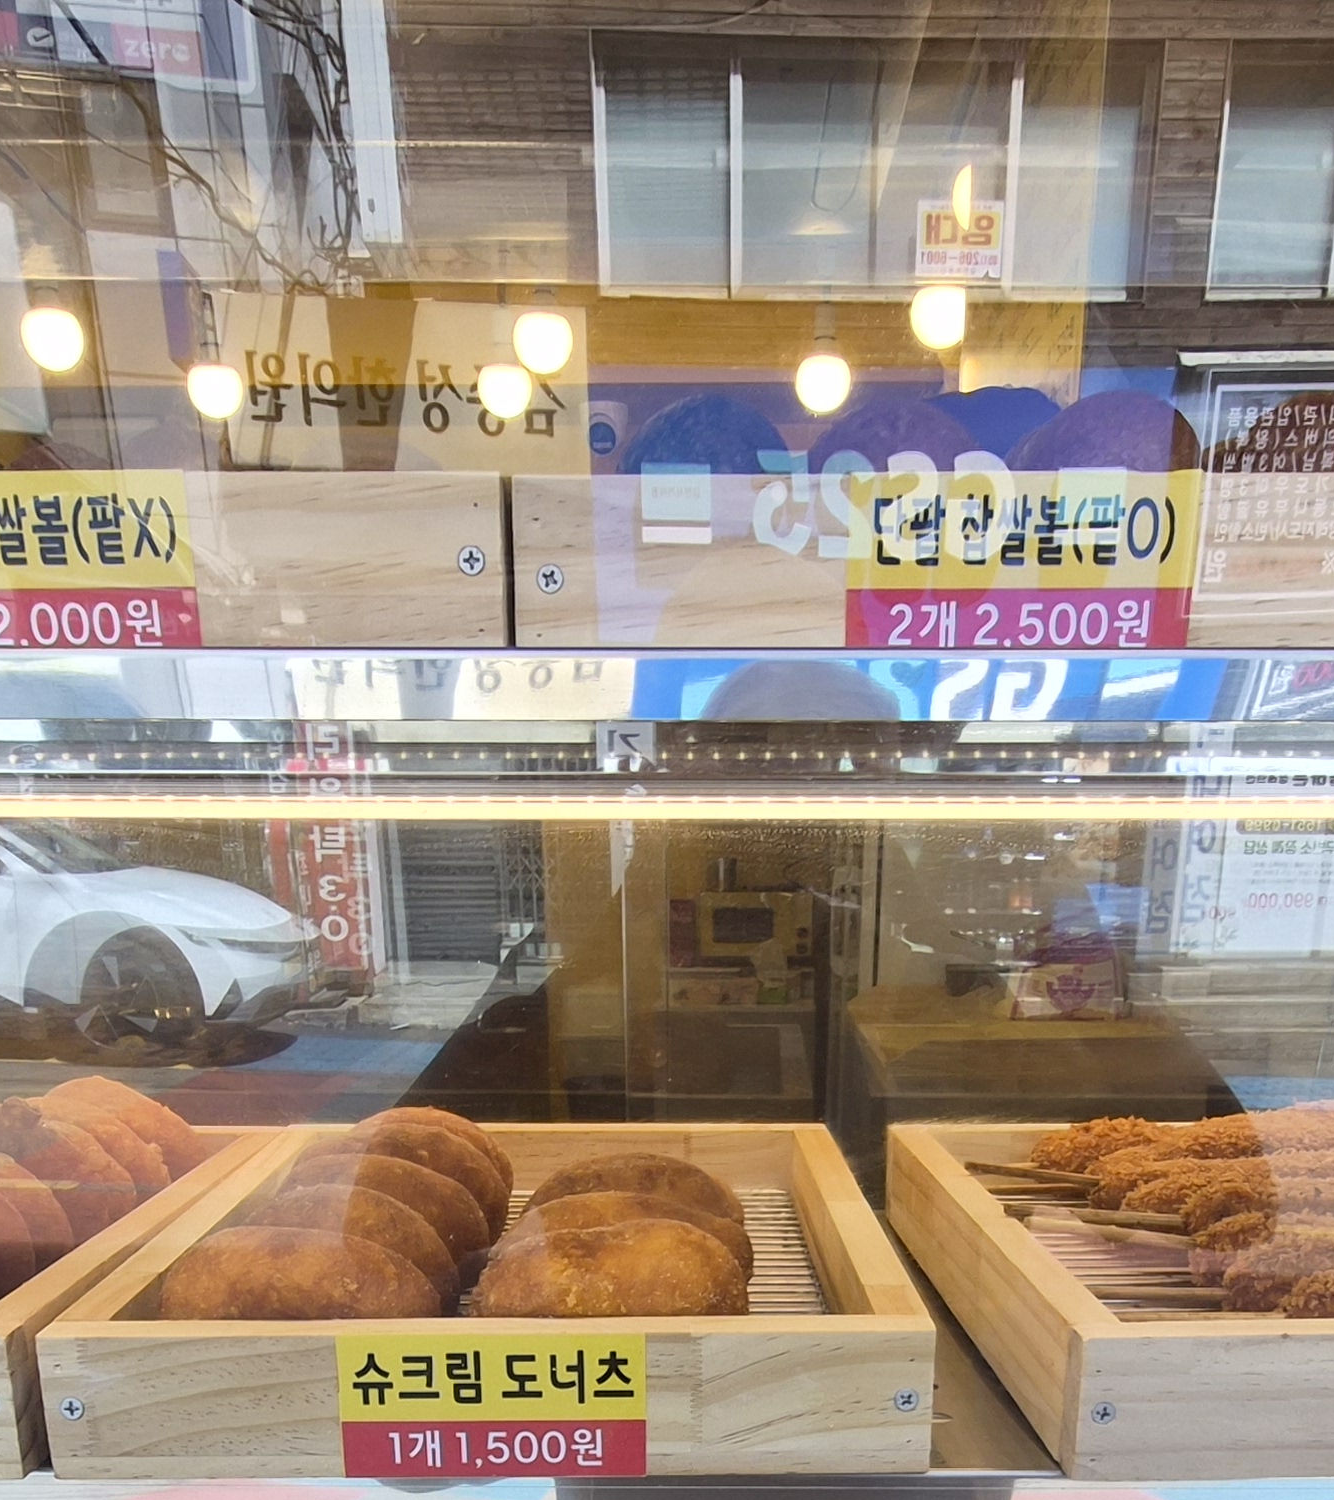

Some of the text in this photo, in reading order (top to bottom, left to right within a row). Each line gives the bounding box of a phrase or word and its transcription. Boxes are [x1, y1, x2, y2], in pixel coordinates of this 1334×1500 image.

[873, 494, 946, 566] 단팥
[887, 601, 957, 648] 2개
[352, 1350, 636, 1406] 슈크림 도너츠
[388, 1428, 604, 1469] 1개 1,500원
